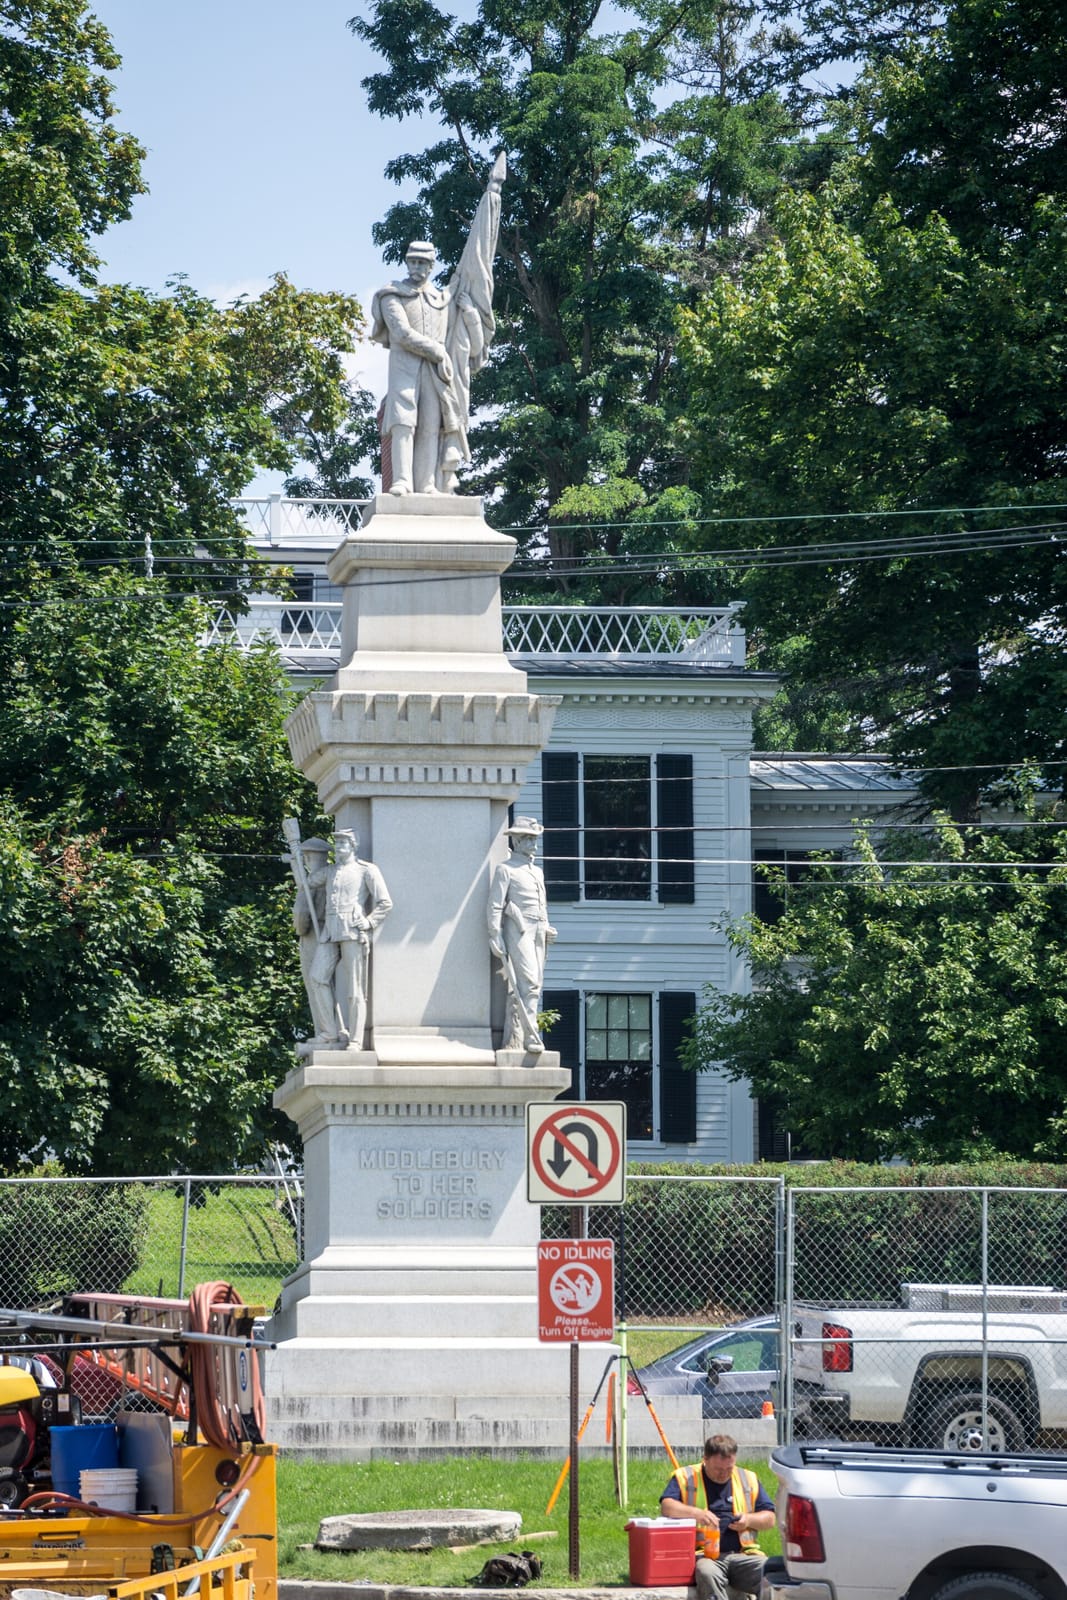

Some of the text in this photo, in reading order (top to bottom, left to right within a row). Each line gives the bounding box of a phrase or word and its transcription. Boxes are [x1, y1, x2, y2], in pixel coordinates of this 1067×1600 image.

[359, 1150, 506, 1169] MIDDLEBURY
[392, 1174, 477, 1195] TO HER
[377, 1200, 493, 1219] SOLDIERS
[539, 1246, 613, 1260] NO IDLING
[540, 1326, 613, 1338] Turn Off Engine
